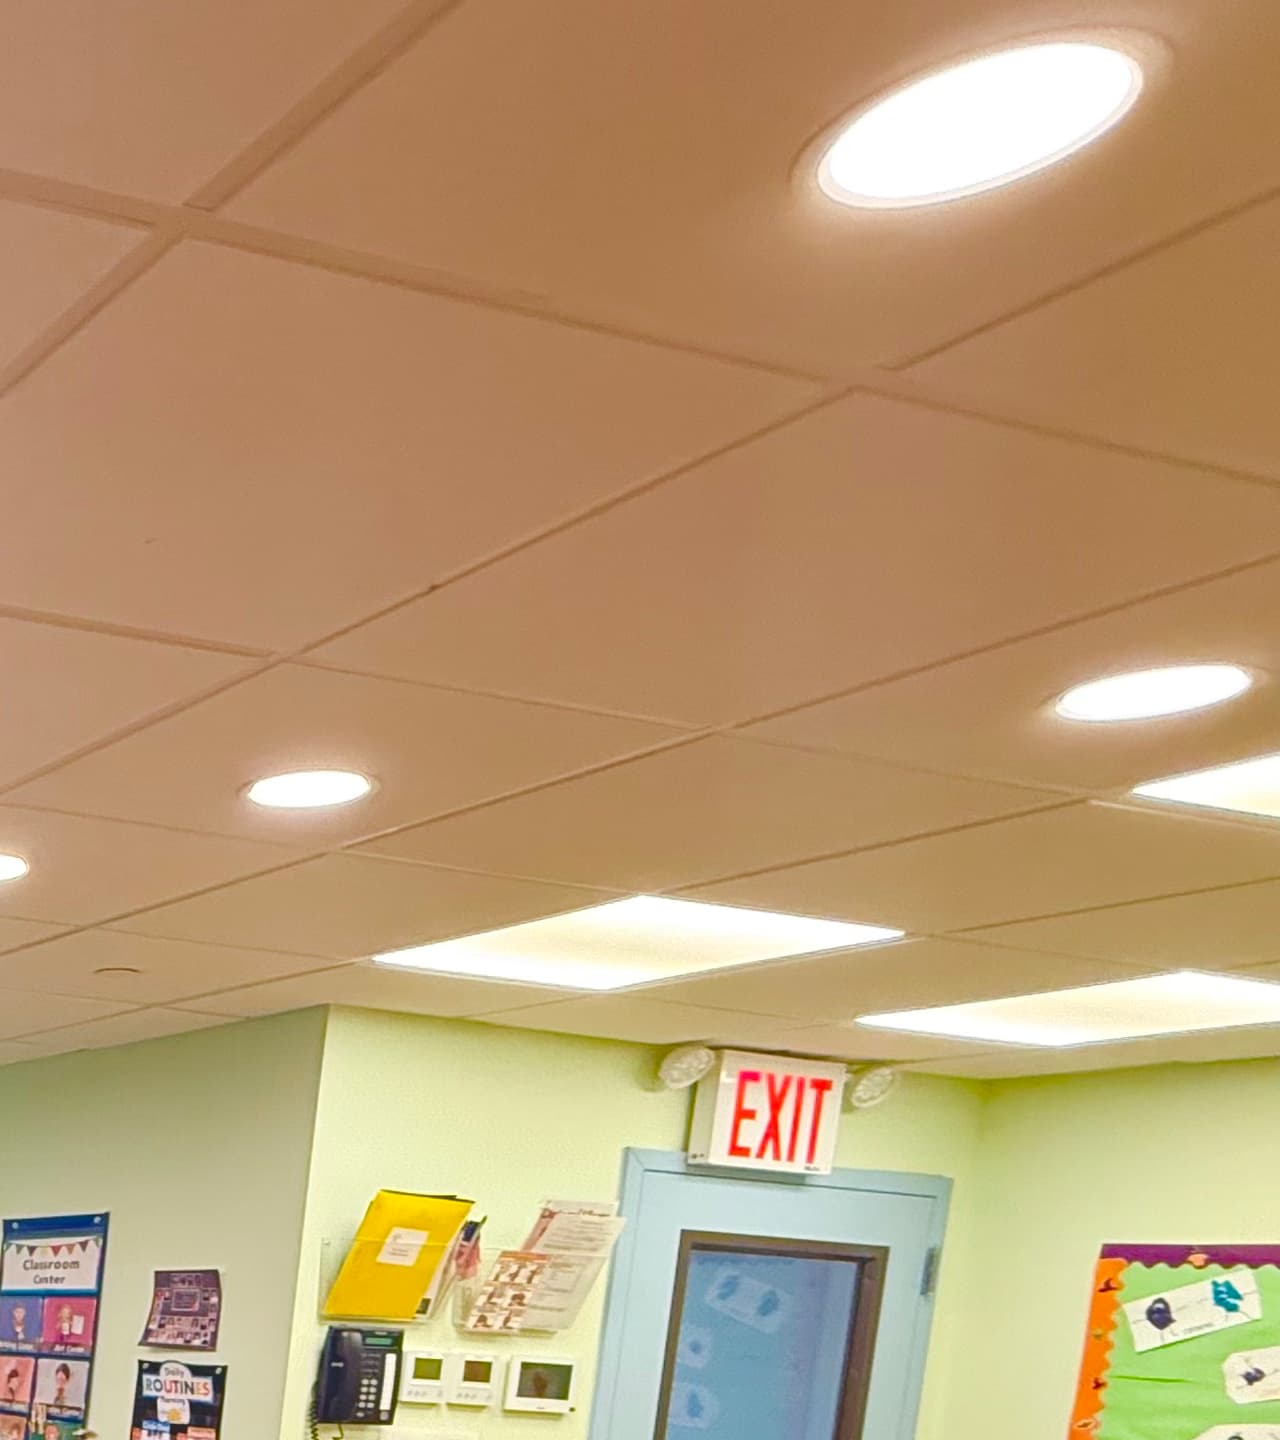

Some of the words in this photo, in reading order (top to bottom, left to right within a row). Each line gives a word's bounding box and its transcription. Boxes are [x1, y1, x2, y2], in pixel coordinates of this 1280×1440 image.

[728, 1070, 833, 1164] EXIT
[23, 1259, 80, 1271] Classroom
[145, 1378, 210, 1396] ROUTINES
